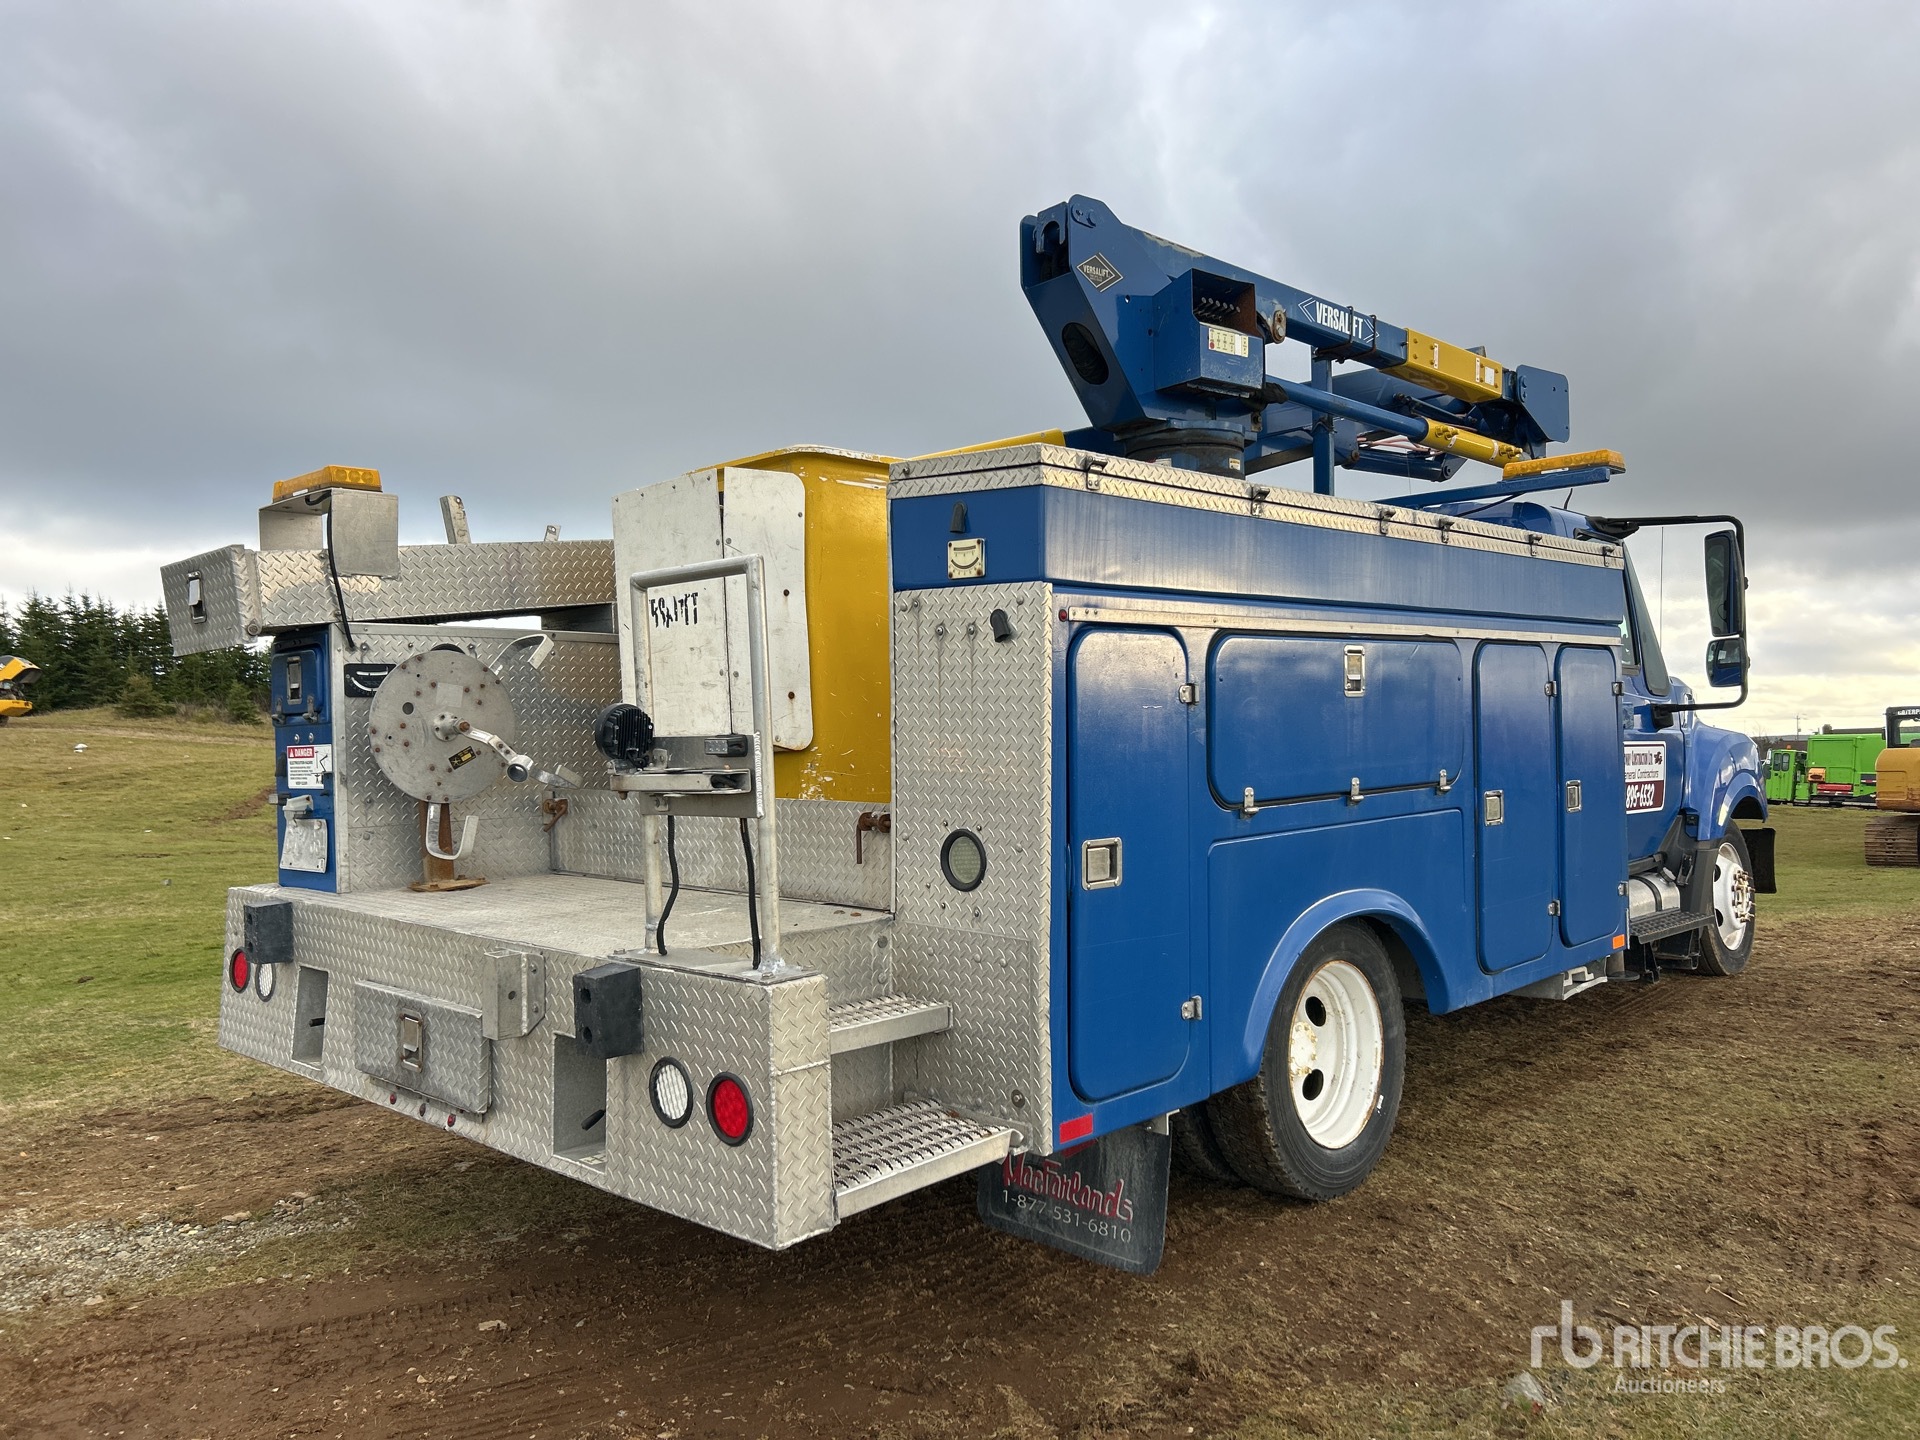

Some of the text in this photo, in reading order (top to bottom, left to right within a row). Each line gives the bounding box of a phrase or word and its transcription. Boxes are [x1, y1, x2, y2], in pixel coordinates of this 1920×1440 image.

[1315, 300, 1364, 340] VERSALFT
[294, 747, 313, 758] DANGER
[1625, 768, 1659, 780] eneral Contractors
[1625, 783, 1655, 809] 895-6532
[1002, 1189, 1131, 1244] 1-877-531-6810
